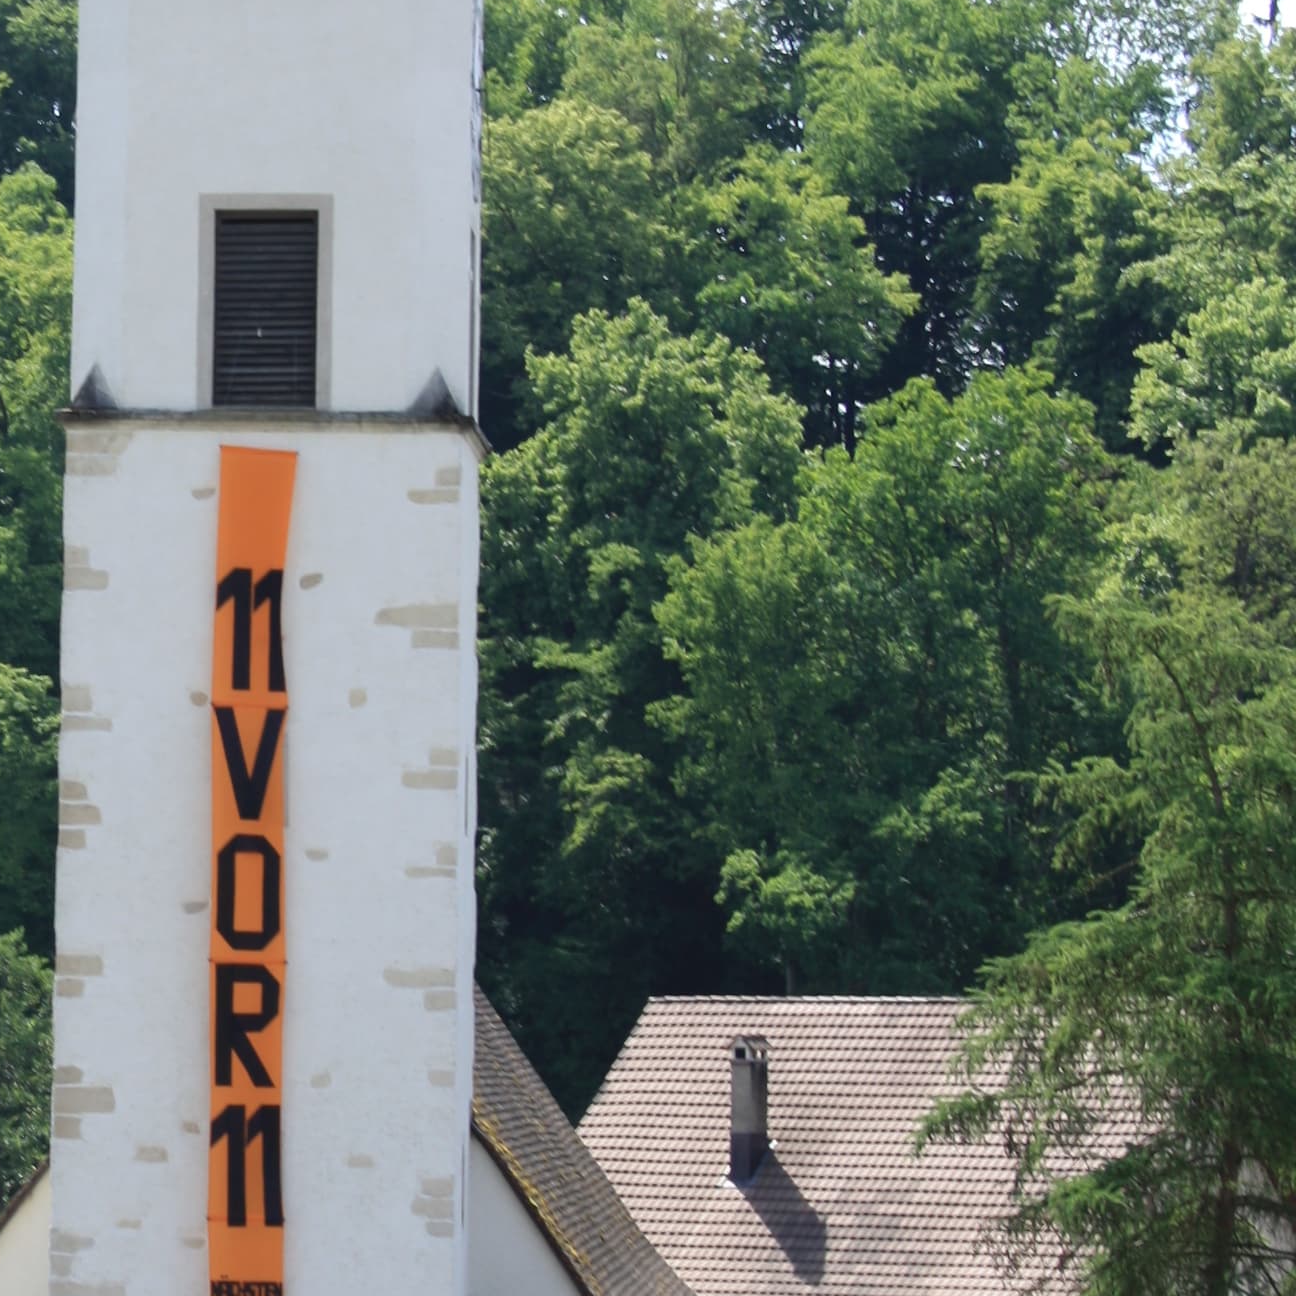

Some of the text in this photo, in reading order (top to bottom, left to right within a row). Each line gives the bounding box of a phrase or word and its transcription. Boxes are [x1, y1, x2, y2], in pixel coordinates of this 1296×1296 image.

[210, 568, 287, 1227] 11 VOR 11
